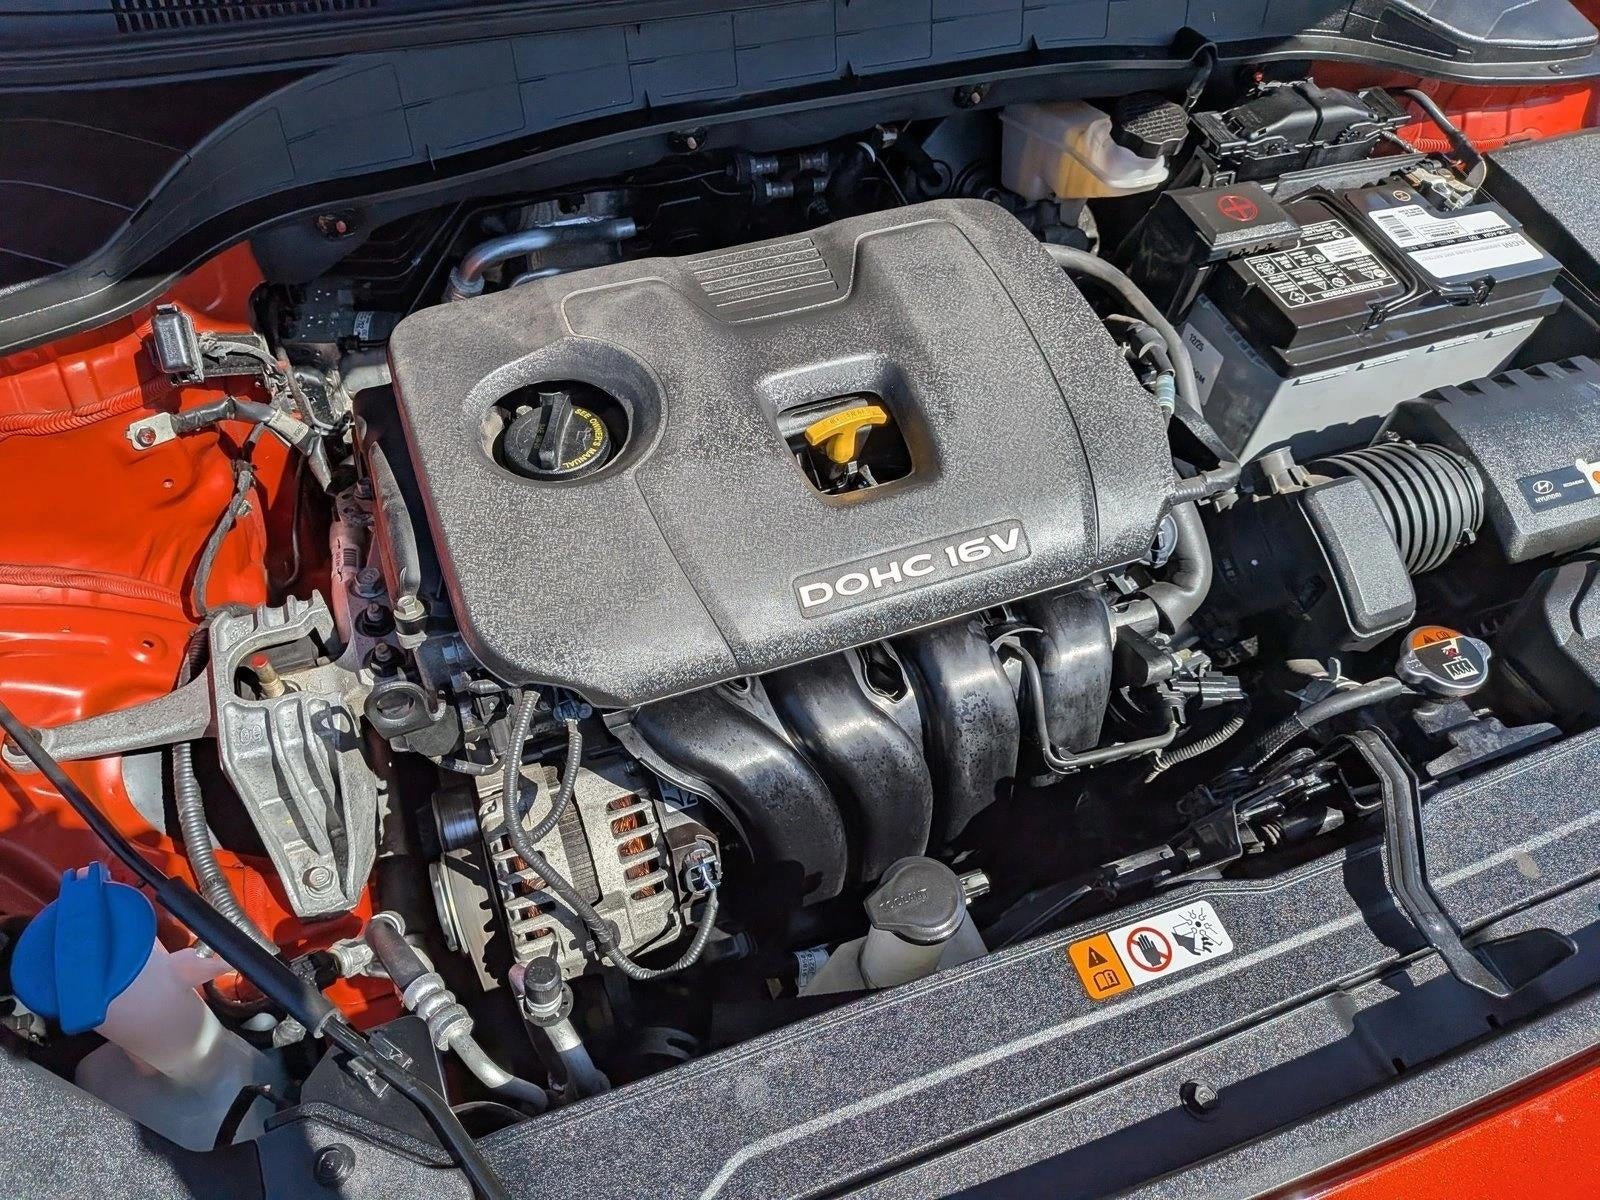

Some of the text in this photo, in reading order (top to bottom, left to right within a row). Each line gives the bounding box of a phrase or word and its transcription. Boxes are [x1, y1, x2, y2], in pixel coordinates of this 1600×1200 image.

[562, 408, 603, 468] SEE OWNER'S MANUAL
[1535, 492, 1562, 503] HYUNDAI
[798, 527, 1019, 608] DOHC 16V
